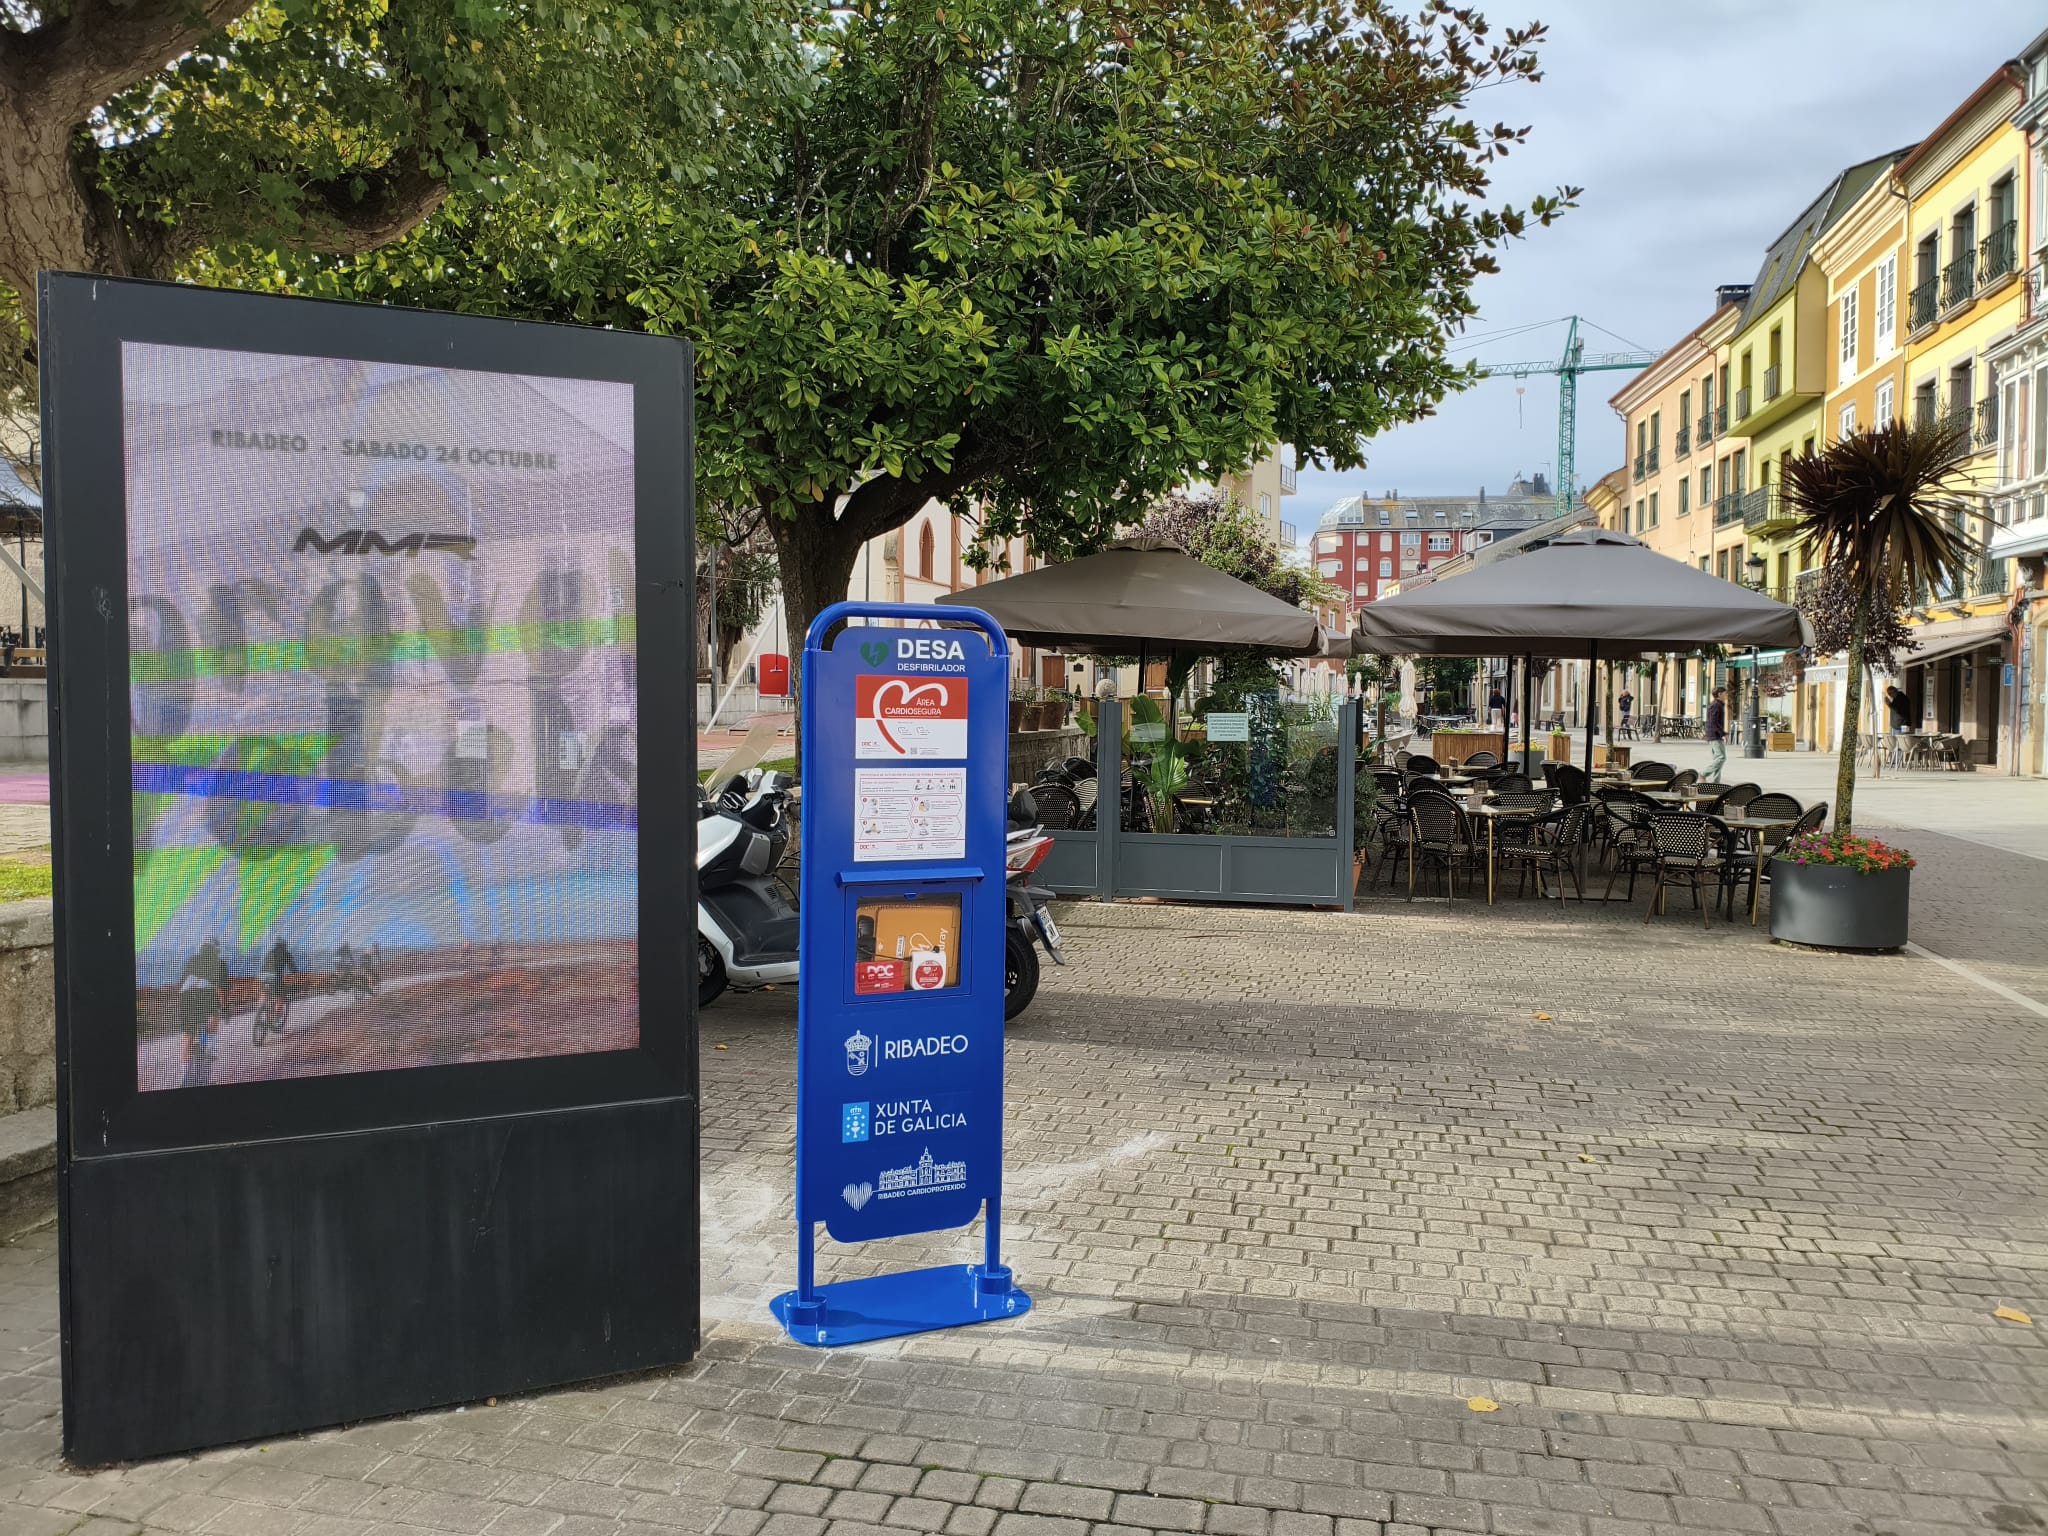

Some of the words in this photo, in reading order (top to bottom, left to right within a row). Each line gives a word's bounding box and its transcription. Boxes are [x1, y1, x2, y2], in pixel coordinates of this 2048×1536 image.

[211, 429, 308, 452] RIBADEO
[342, 439, 429, 461] SABADO
[437, 446, 460, 463] 24
[467, 449, 558, 471] OCTUBRE
[897, 638, 966, 660] DESA
[897, 663, 966, 672] DESFIBRILADOR
[885, 707, 942, 715] CARDIOSEGURA
[885, 1034, 969, 1060] RIBADEO
[875, 1099, 933, 1119] XUNTA
[874, 1119, 896, 1136] DE
[901, 1112, 967, 1133] GALICIA
[878, 1190, 906, 1200] RIBADEO
[906, 1183, 967, 1196] CARDIOPROTEXIDO
